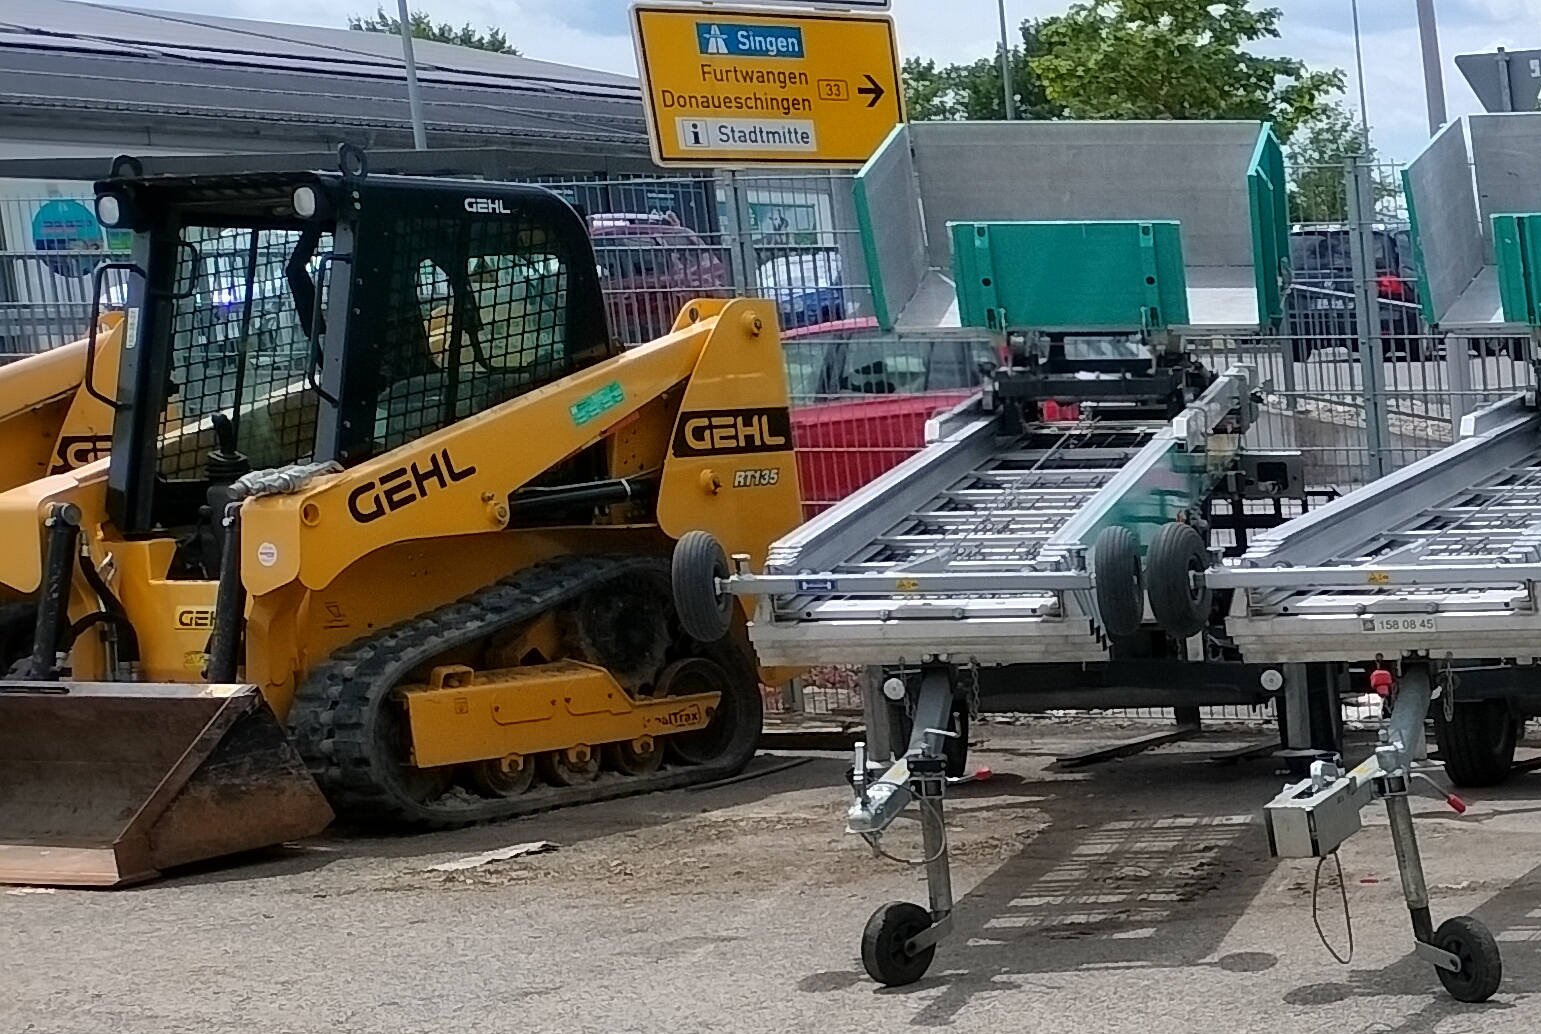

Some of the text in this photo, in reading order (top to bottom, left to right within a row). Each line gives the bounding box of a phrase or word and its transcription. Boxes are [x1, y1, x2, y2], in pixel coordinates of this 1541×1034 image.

[737, 31, 799, 56] Singen
[700, 64, 809, 89] Furtwangen
[825, 83, 841, 97] 33
[661, 89, 812, 115] Donaueschingen
[718, 125, 810, 145] Stadtmitte
[464, 198, 511, 214] GEHL
[684, 414, 786, 450] GEHL
[348, 448, 477, 524] GEHL
[733, 469, 779, 488] RT135
[1379, 618, 1434, 630] 158 08 45
